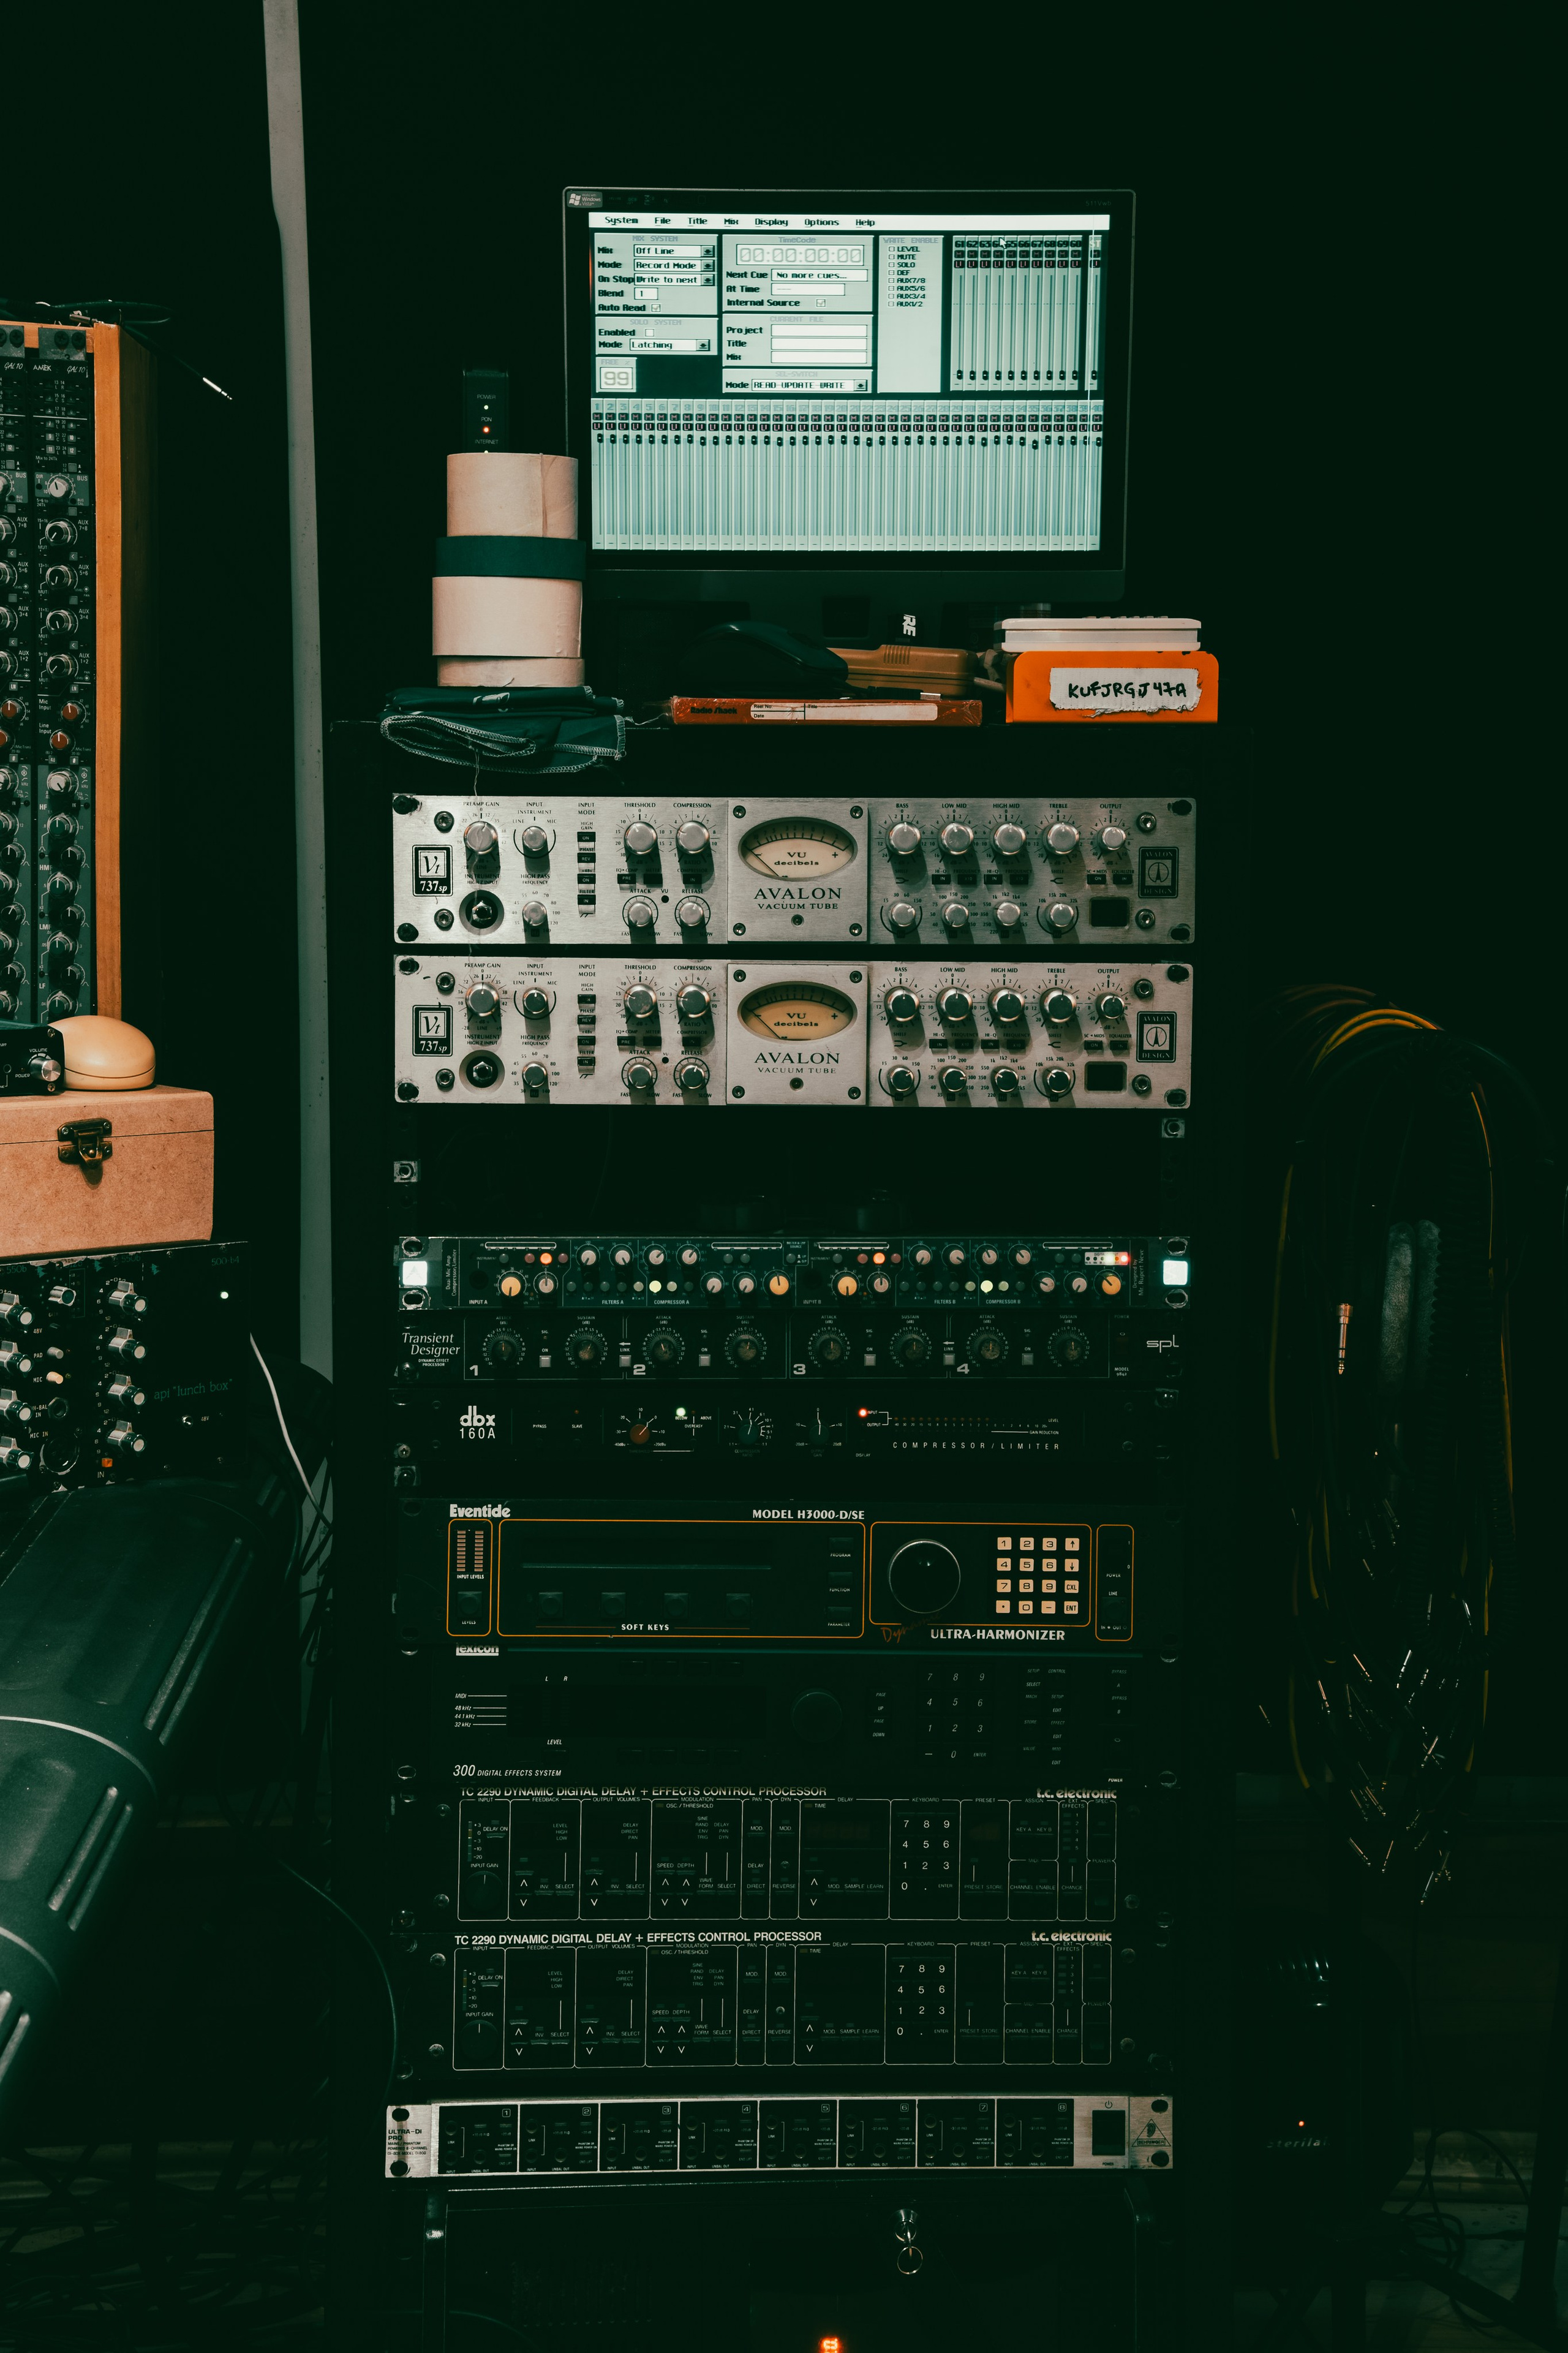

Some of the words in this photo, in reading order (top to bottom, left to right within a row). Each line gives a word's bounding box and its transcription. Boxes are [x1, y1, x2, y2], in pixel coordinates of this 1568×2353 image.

[605, 216, 638, 225] System
[755, 218, 788, 227] Display
[726, 327, 763, 335] Project
[631, 341, 672, 350] Latching
[604, 371, 629, 386] 99
[754, 888, 842, 899] AVALON
[754, 1052, 840, 1064] AVALON
[402, 1332, 454, 1344] Transient
[1146, 1335, 1180, 1353] spl
[410, 1343, 460, 1358] Designer
[469, 1365, 478, 1376] 1
[633, 1364, 646, 1375] 2
[793, 1363, 806, 1374] 3
[957, 1363, 970, 1374] 4
[459, 1405, 496, 1427] dbx
[459, 1427, 496, 1440] 160A
[450, 1504, 510, 1519] Eventide
[752, 1509, 794, 1519] MODEL
[797, 1510, 865, 1520] H3000-D/SE
[644, 1623, 669, 1631] KEYS
[930, 1629, 1065, 1641] ULTRA-HARMONIZER
[453, 1765, 475, 1777] 300
[477, 1787, 501, 1796] 2290
[504, 1787, 554, 1796] DYNAMIC
[557, 1787, 598, 1796] DIGITAL
[601, 1787, 636, 1796] DELAY
[652, 1787, 700, 1796] EFFECTS
[703, 1787, 755, 1796] CONTROL
[758, 1787, 827, 1796] PROCESSOR
[1057, 1788, 1117, 1799] electronic
[454, 1936, 469, 1944] TC
[472, 1935, 496, 1945] 2290
[499, 1935, 549, 1944] DYNAMIC
[552, 1934, 593, 1944] DIGITAL
[596, 1933, 632, 1944] DELAY
[647, 1933, 695, 1943] EFFECTS
[698, 1932, 751, 1942] CONTROL
[754, 1932, 821, 1941] PROCESSOR
[1031, 1930, 1049, 1941] t.c.
[1051, 1930, 1112, 1942] electronic
